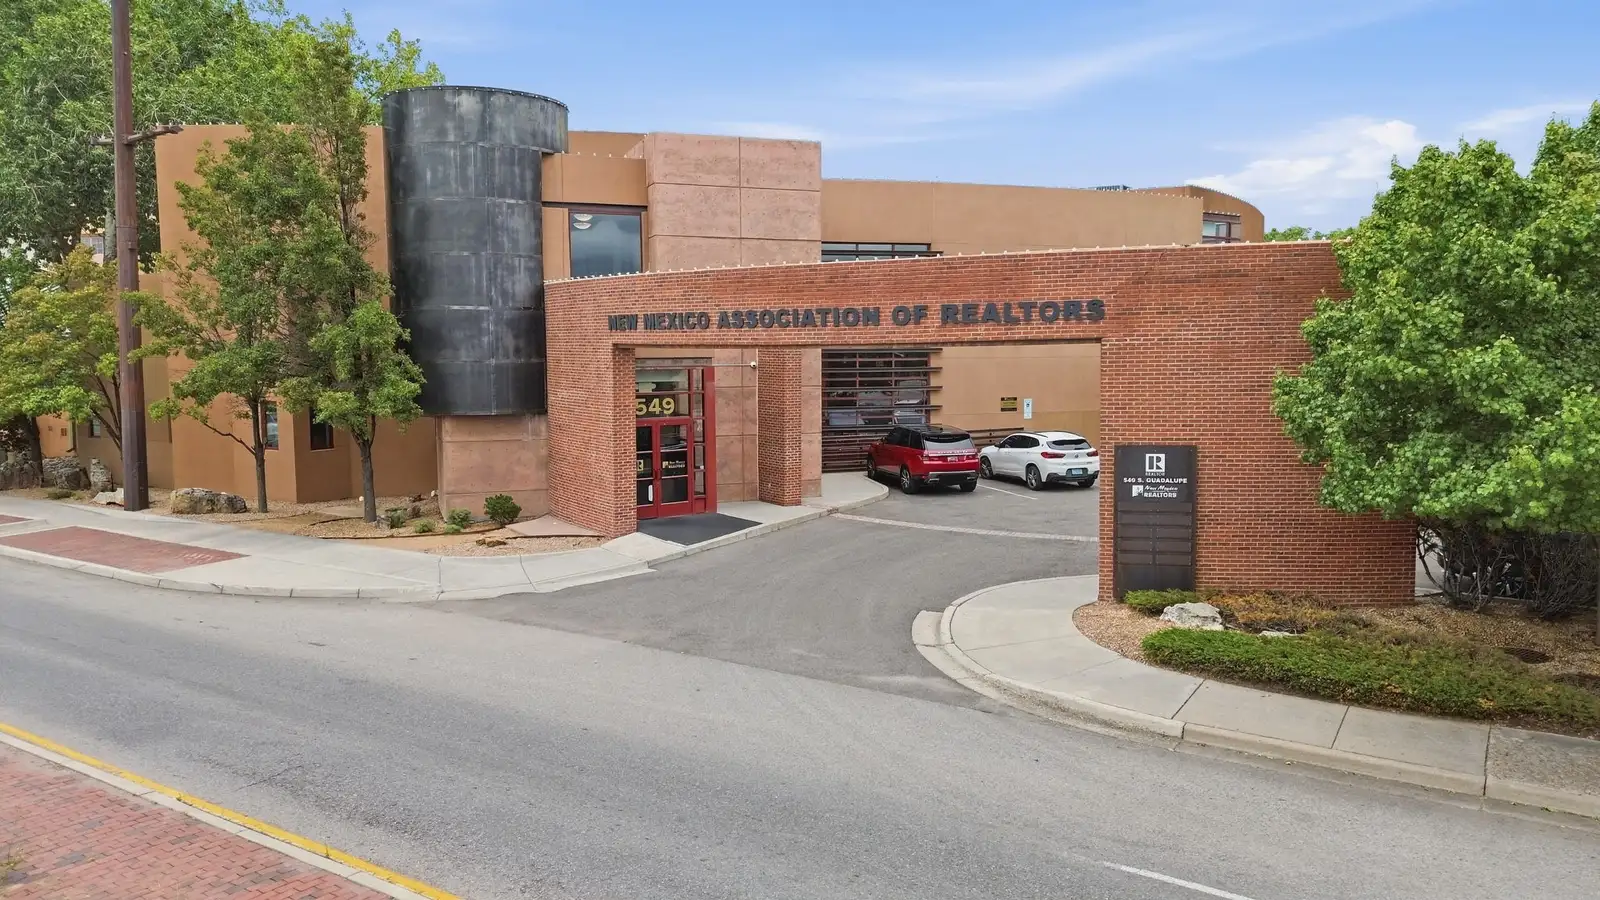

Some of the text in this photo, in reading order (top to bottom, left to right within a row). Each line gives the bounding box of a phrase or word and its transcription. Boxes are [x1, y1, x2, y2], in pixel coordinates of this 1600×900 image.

[607, 299, 1105, 331] NEW MEXICO ASSOCIATION OF REALTORS
[636, 397, 675, 415] 549
